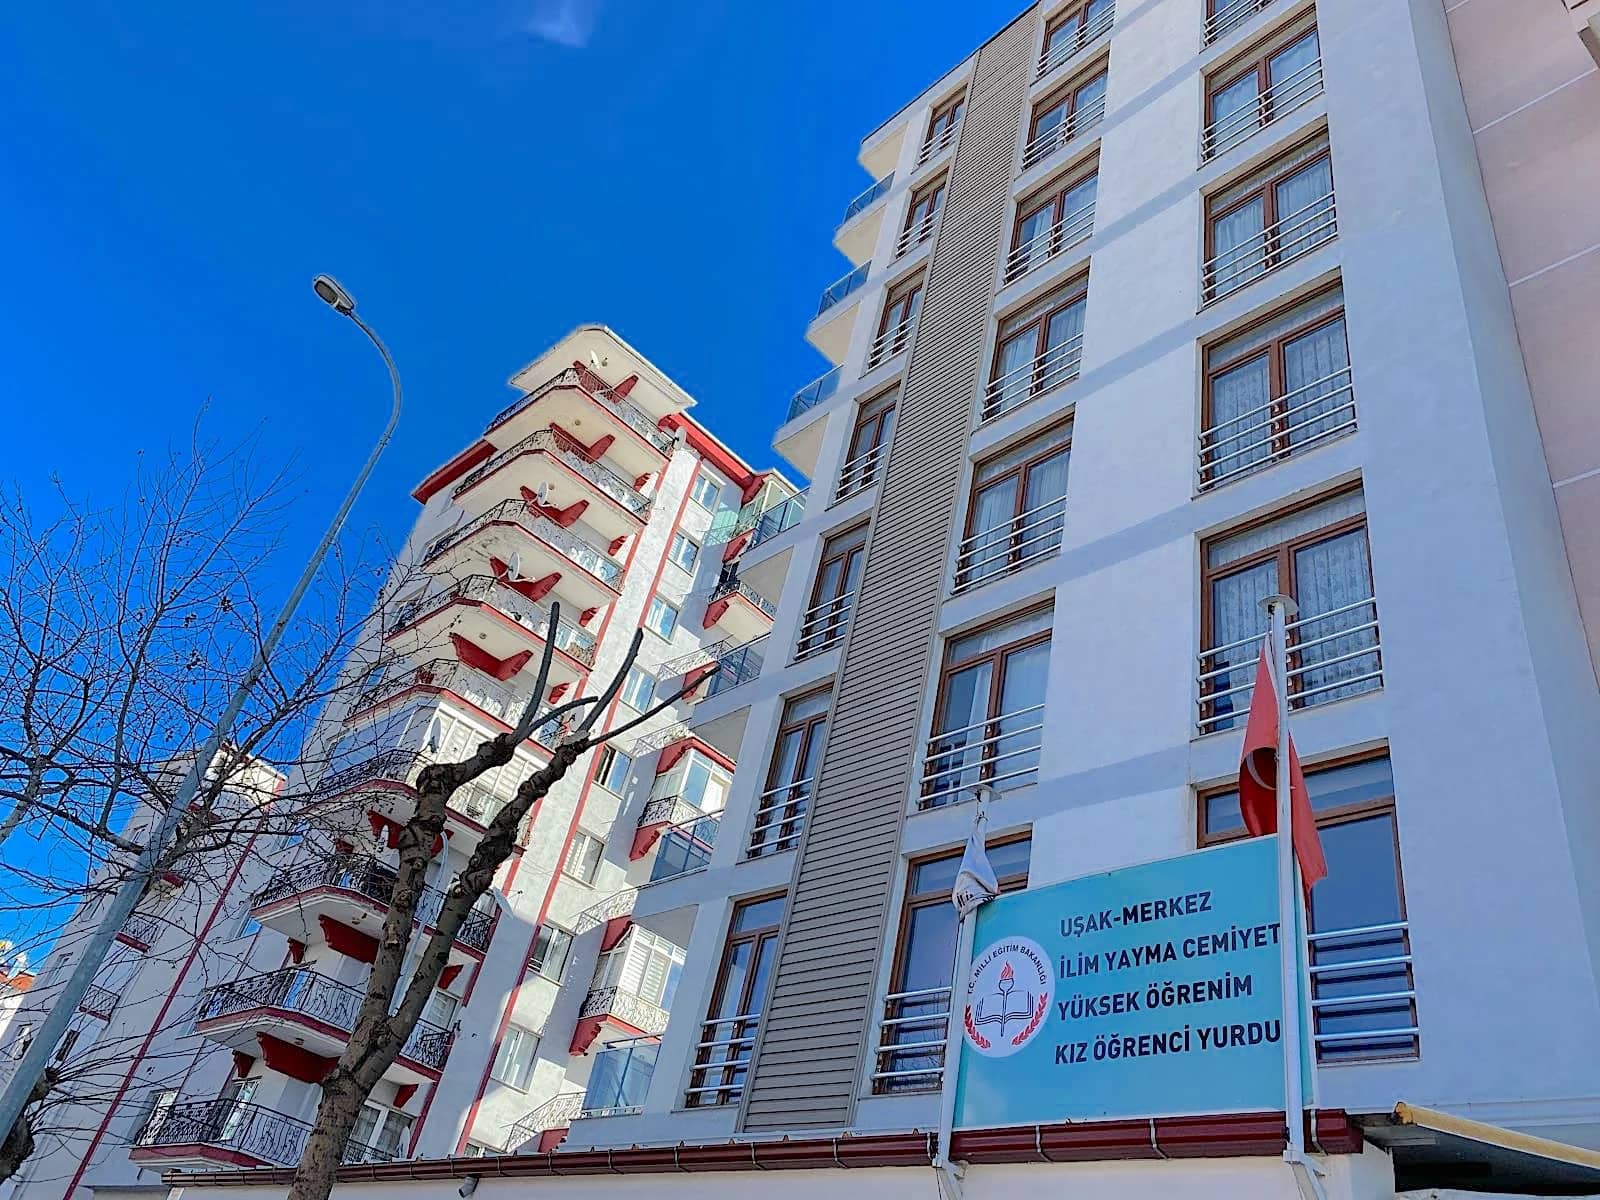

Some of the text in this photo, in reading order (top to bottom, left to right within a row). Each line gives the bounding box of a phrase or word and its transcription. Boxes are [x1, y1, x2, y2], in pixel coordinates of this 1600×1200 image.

[1060, 891, 1212, 938] UŞAK-MERKEZ
[1020, 946, 1048, 985] BAKANLIĞI
[1060, 951, 1099, 979] İLİM
[1104, 941, 1177, 972] YAYMA
[1057, 971, 1252, 1021] YÜKSEK ÖĞRENİM
[1055, 1019, 1281, 1065] KIZ ÖĞRENCİ YURDU
